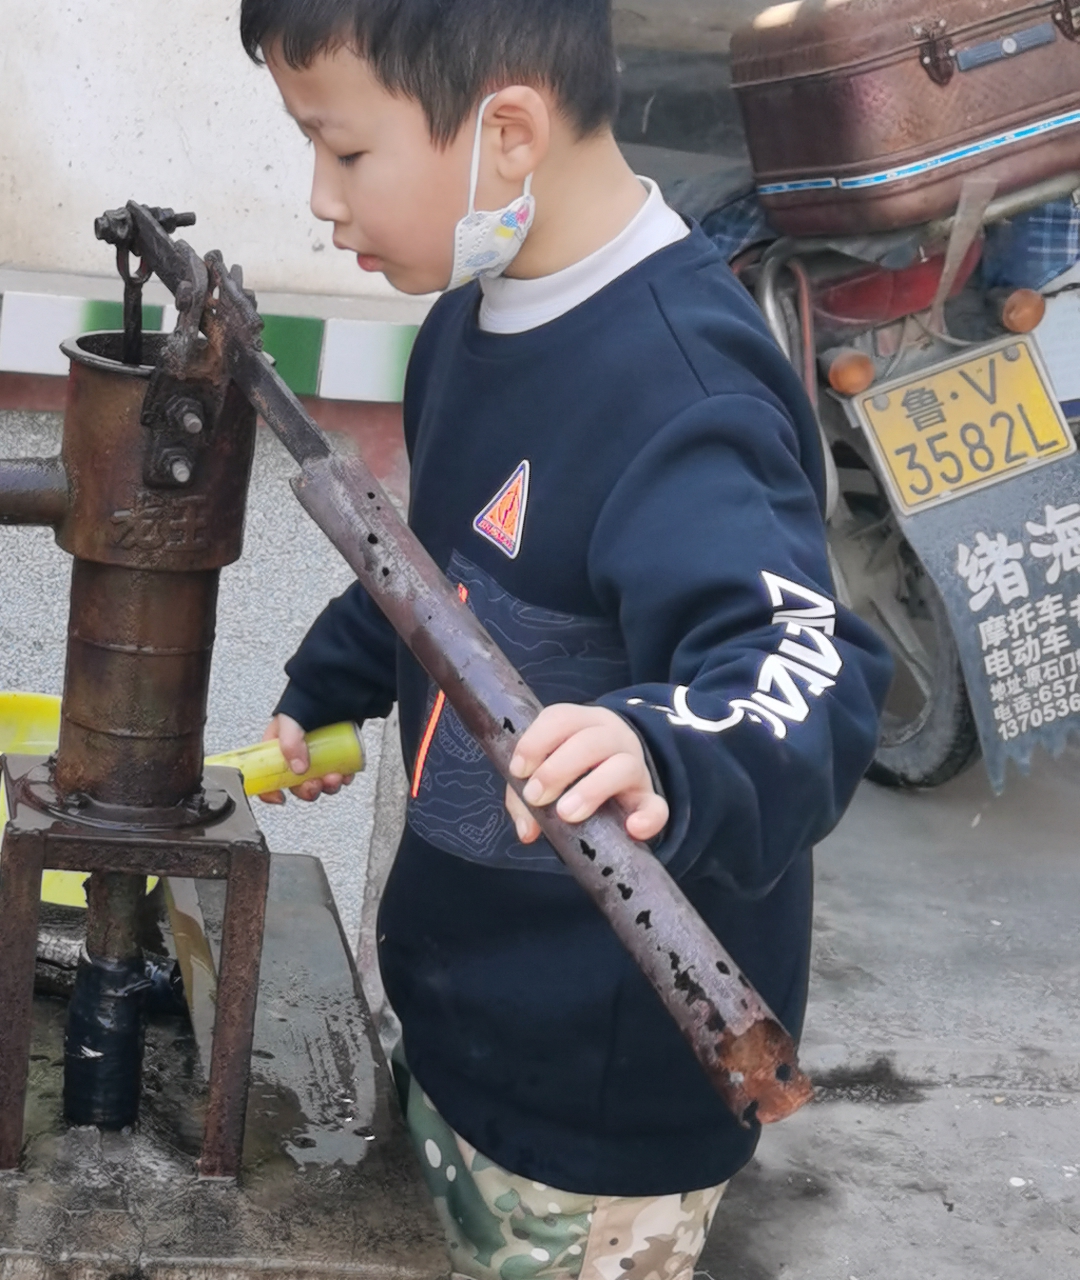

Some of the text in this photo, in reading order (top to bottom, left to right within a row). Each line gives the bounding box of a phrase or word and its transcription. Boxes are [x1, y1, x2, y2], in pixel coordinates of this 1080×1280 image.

[901, 358, 997, 432] 鲁·V
[894, 403, 1060, 496] 3582L
[984, 624, 1071, 678] 电动车
[990, 647, 1080, 701] 地址:原石门
[993, 673, 1079, 721] 电话:657
[998, 692, 1080, 741] 1370536
